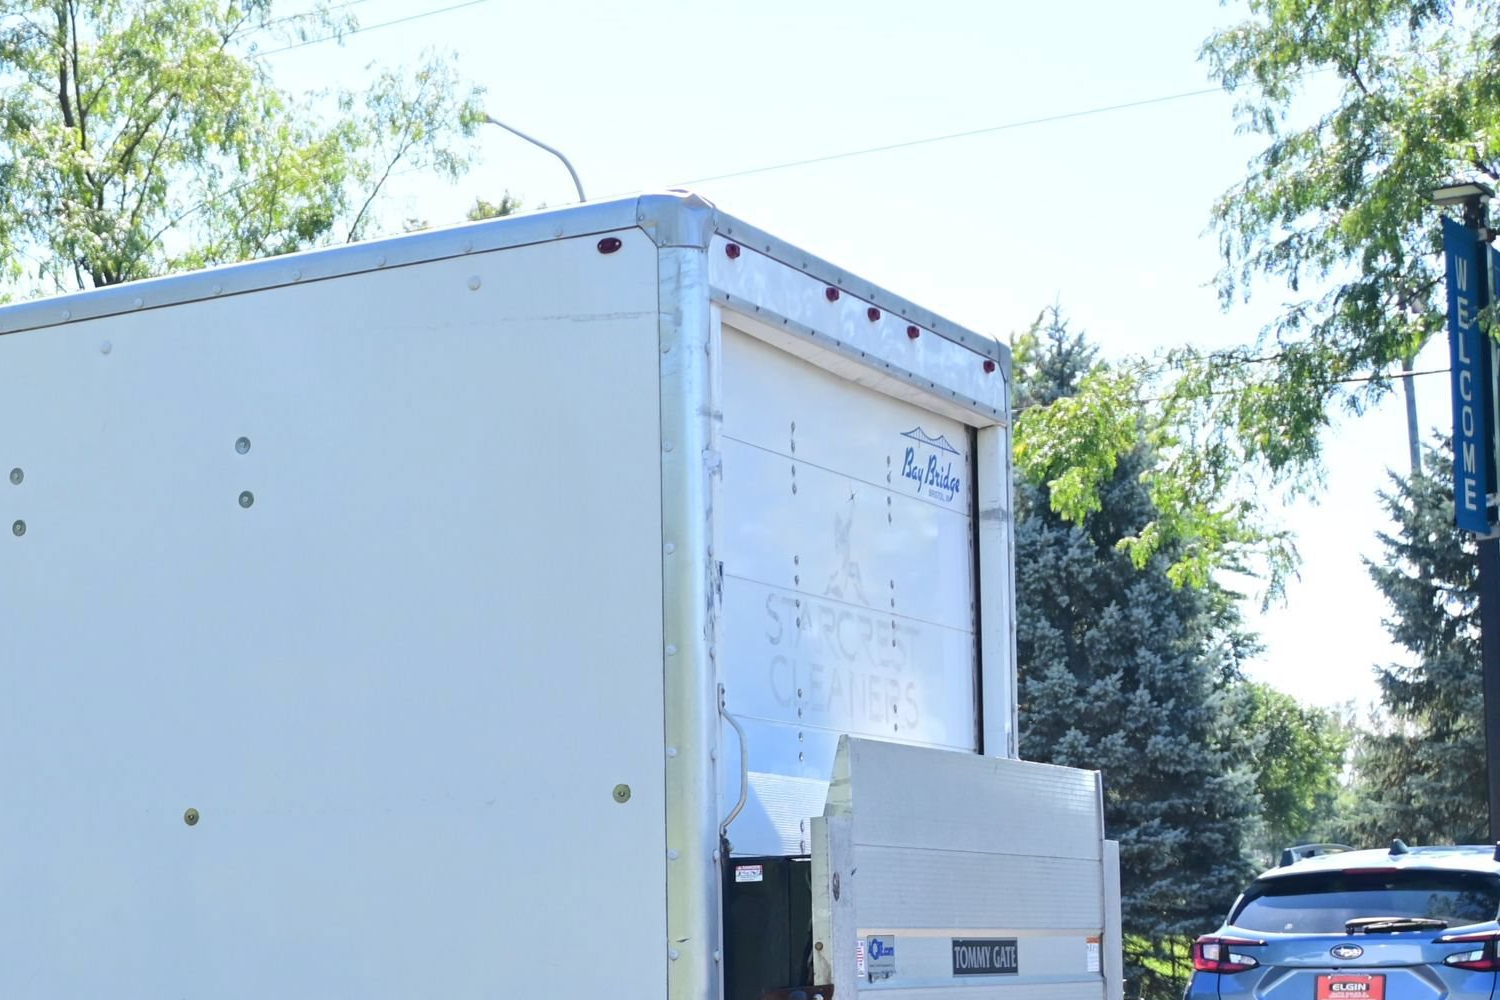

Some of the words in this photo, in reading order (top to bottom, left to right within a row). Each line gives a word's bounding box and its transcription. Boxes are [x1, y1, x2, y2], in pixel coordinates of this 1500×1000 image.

[1454, 254, 1477, 511] WELCOME
[901, 446, 924, 493] Bay
[924, 454, 960, 501] Bridge
[766, 593, 921, 673] STARCREST
[770, 654, 920, 729] CLEANERS
[954, 946, 991, 968] TOMMY
[993, 946, 1017, 968] GATE
[1332, 983, 1367, 991] ELGIN
